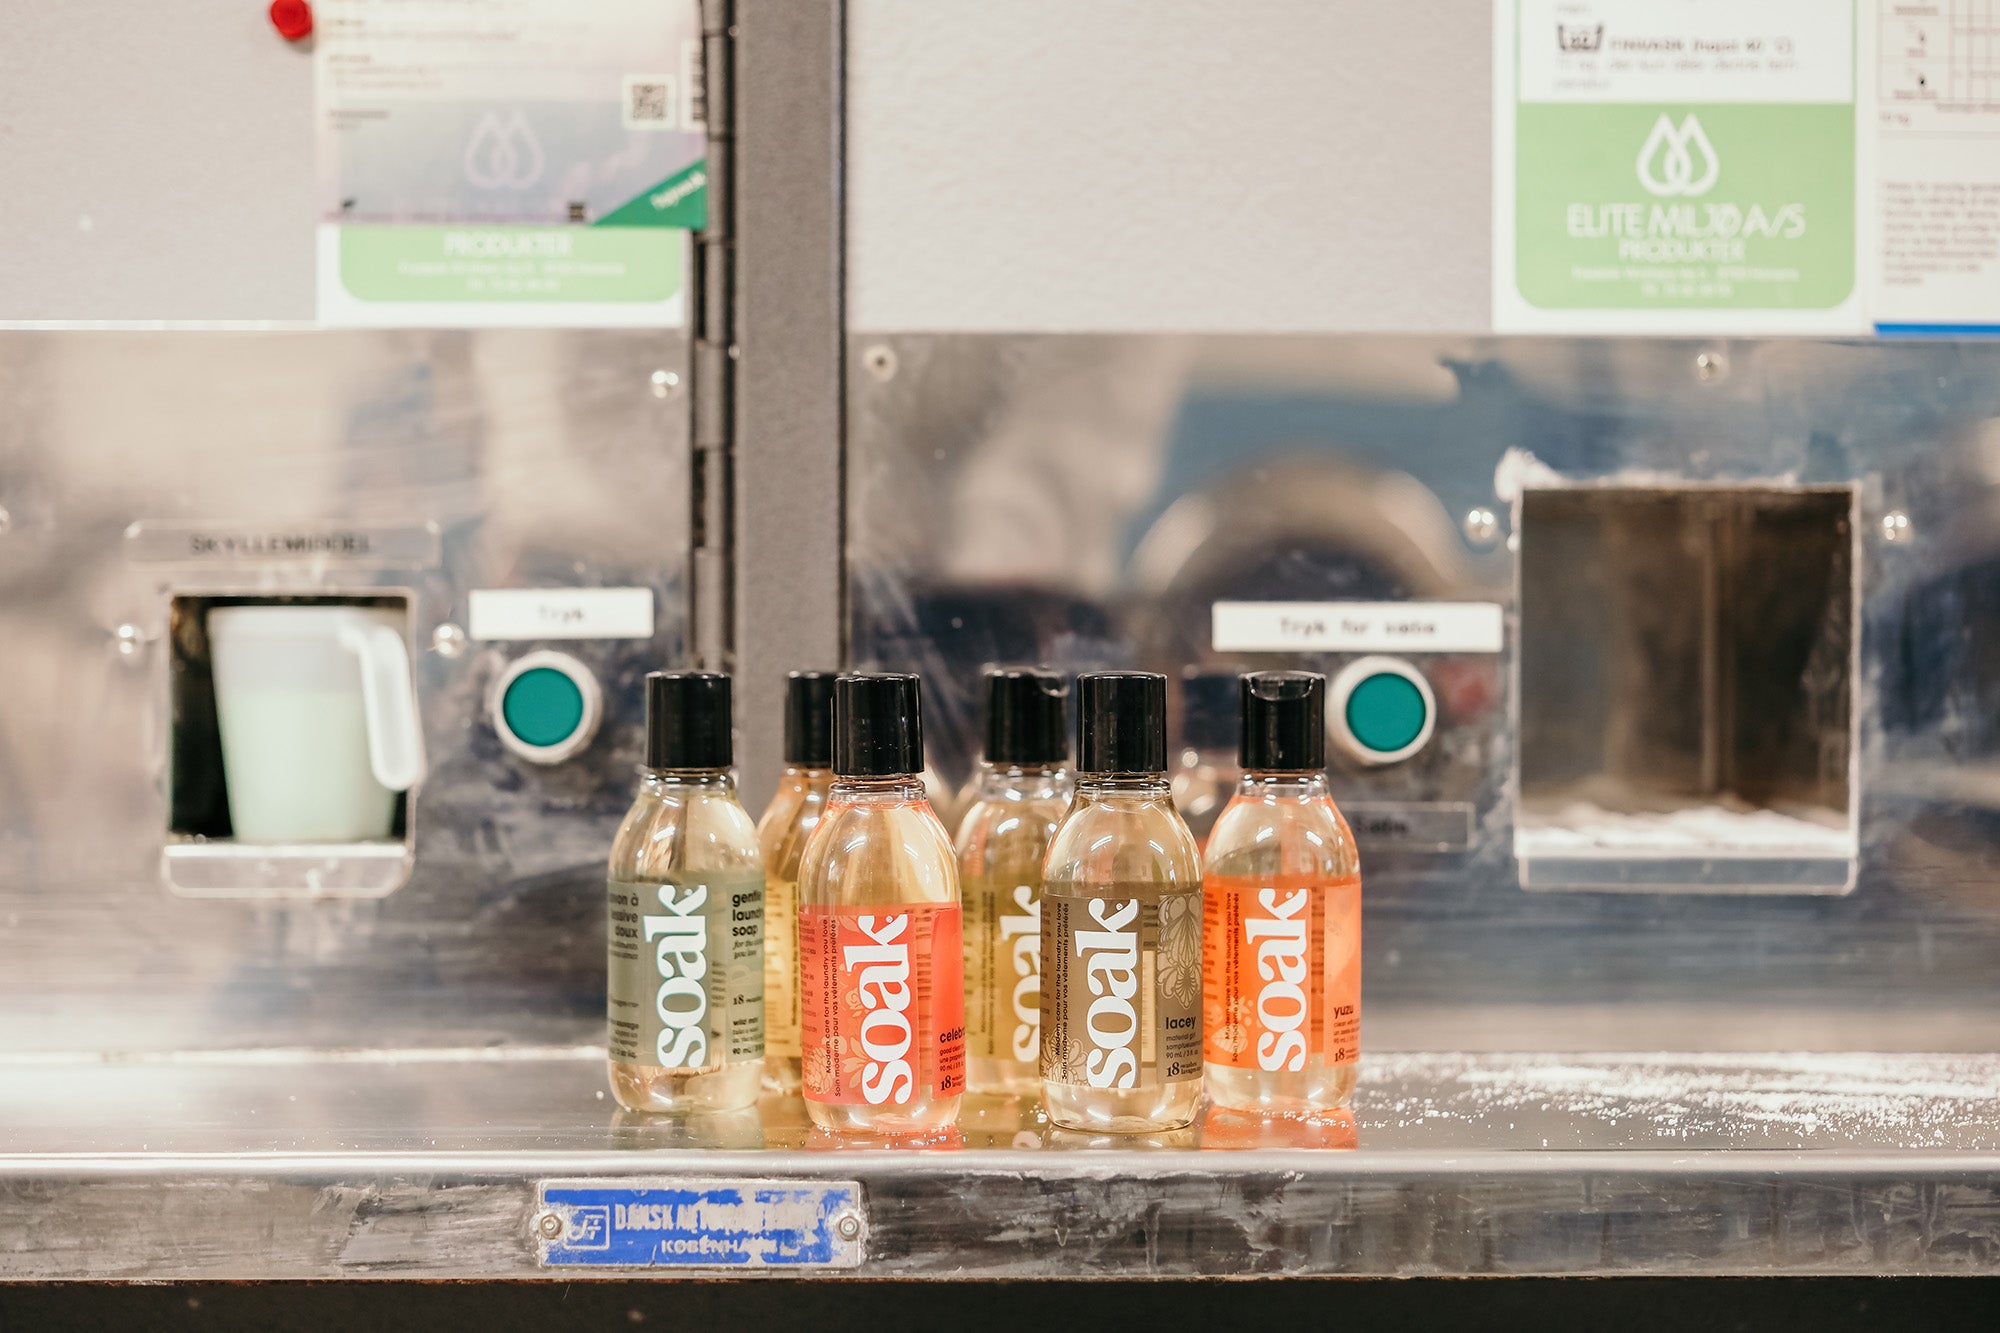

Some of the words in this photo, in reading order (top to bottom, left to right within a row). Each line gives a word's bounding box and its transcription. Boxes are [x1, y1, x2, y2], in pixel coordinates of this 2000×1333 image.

[1567, 203, 1643, 236] ELITE
[643, 884, 708, 1068] soak
[1244, 888, 1307, 1072] soak
[732, 994, 745, 1006] 18
[1074, 898, 1138, 1088] soak
[843, 914, 913, 1105] soak
[1334, 1005, 1354, 1019] yuzu
[1166, 1016, 1197, 1030] lacey
[1334, 1048, 1345, 1063] 18
[1166, 1061, 1180, 1077] 18
[940, 1074, 951, 1091] 18
